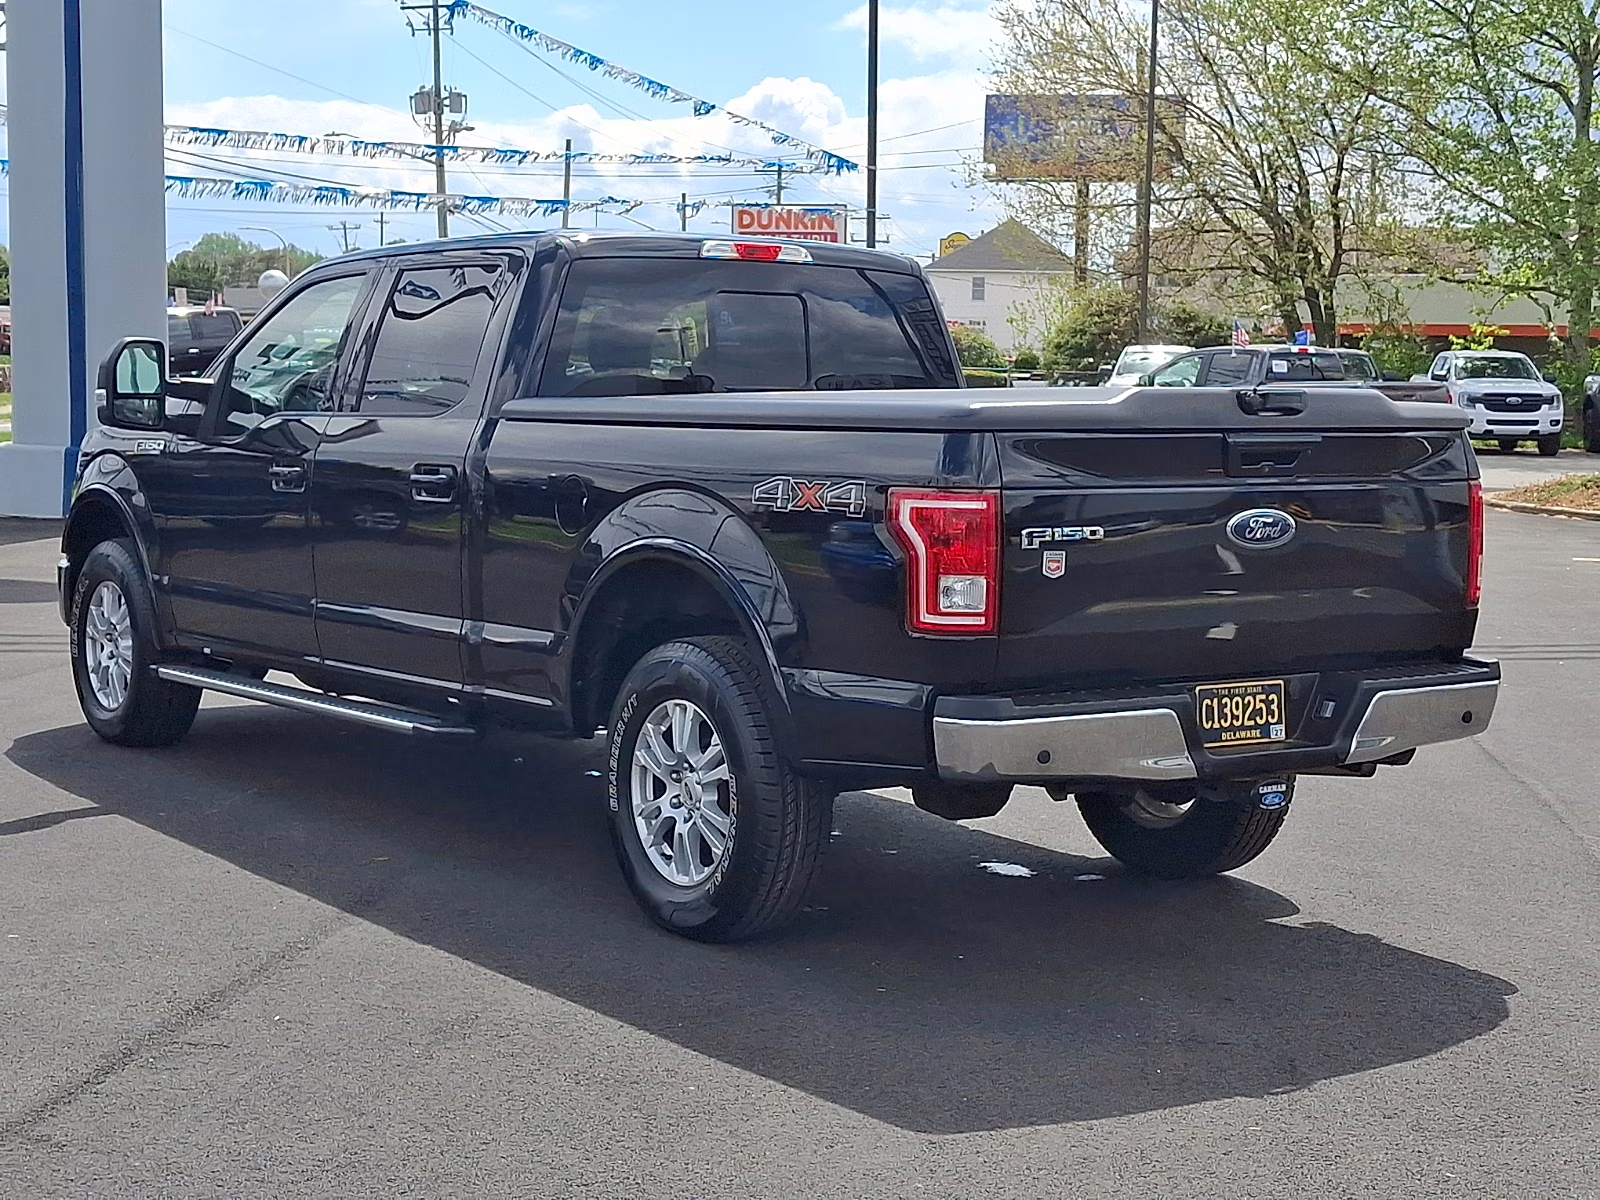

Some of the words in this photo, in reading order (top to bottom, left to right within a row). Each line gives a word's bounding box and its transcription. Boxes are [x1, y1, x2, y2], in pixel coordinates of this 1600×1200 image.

[1021, 526, 1104, 549] F150
[1245, 517, 1282, 539] Ford
[1202, 693, 1279, 729] C139253
[1221, 729, 1262, 740] DELAWARE
[1274, 729, 1283, 737] 27
